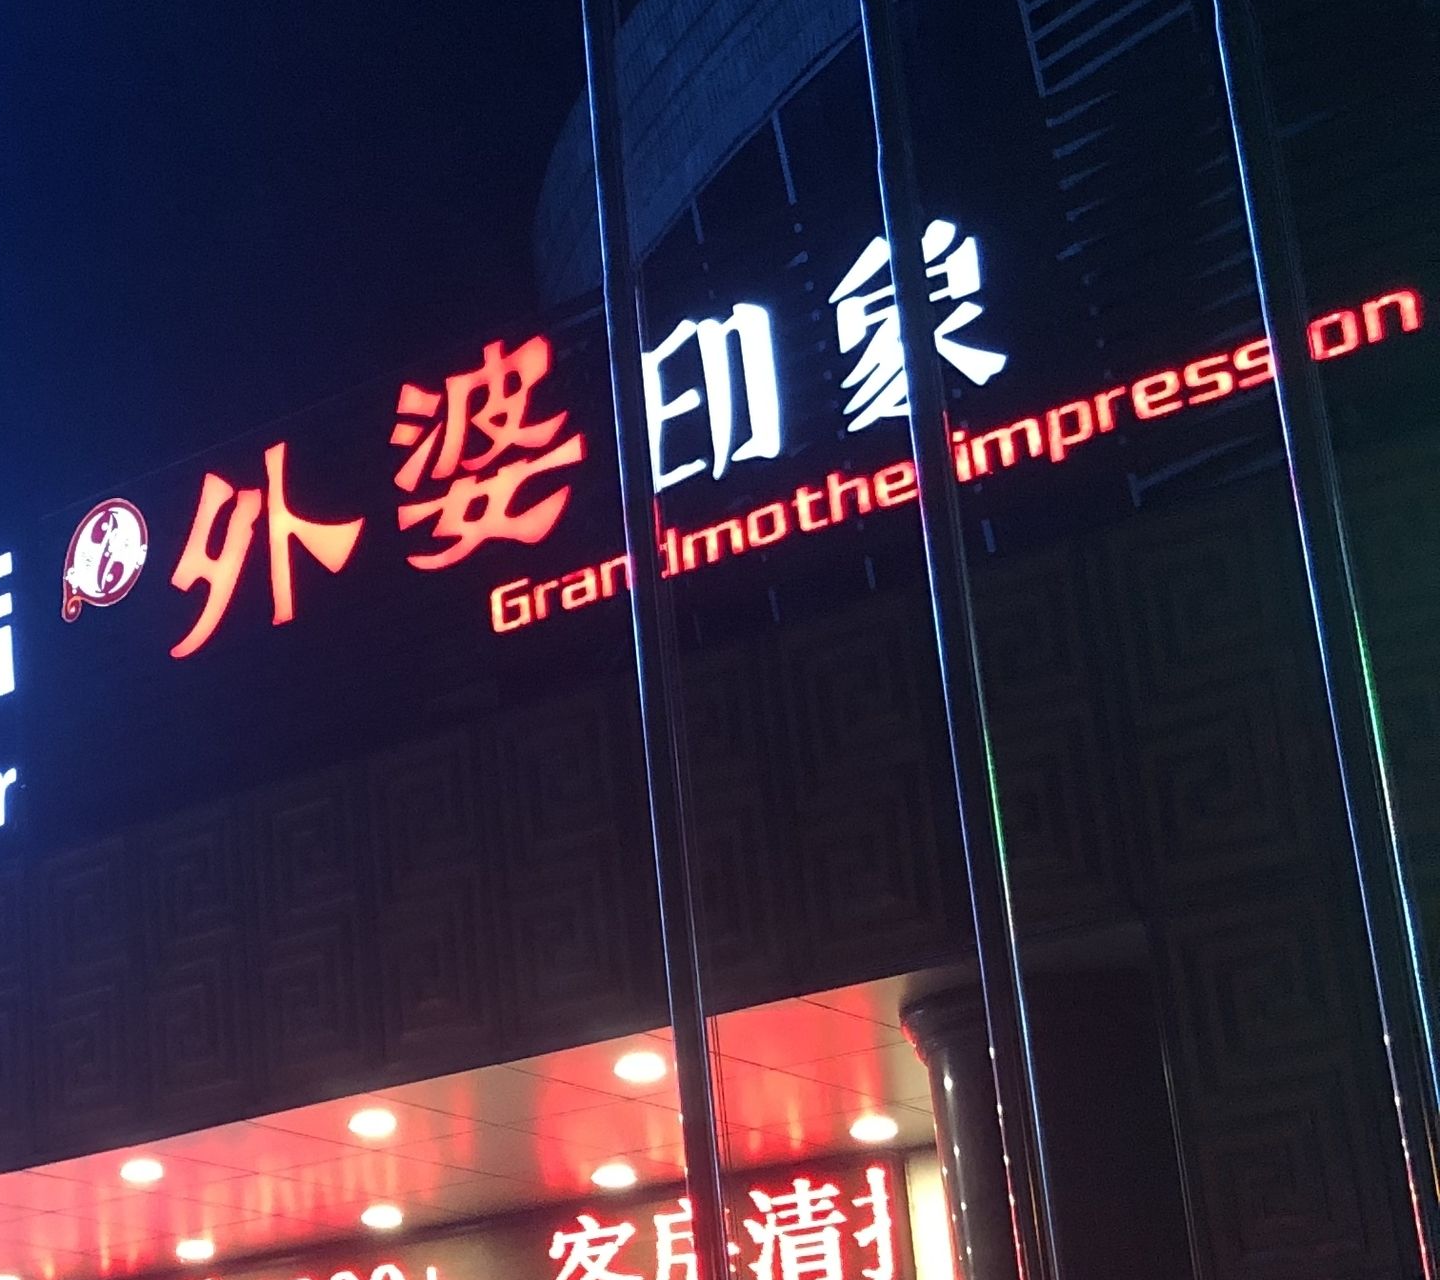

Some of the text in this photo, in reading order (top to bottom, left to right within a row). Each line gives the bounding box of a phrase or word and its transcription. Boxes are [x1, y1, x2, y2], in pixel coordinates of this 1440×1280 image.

[170, 218, 1008, 658] 外婆印象
[490, 287, 1424, 634] Grandmothe impresson
